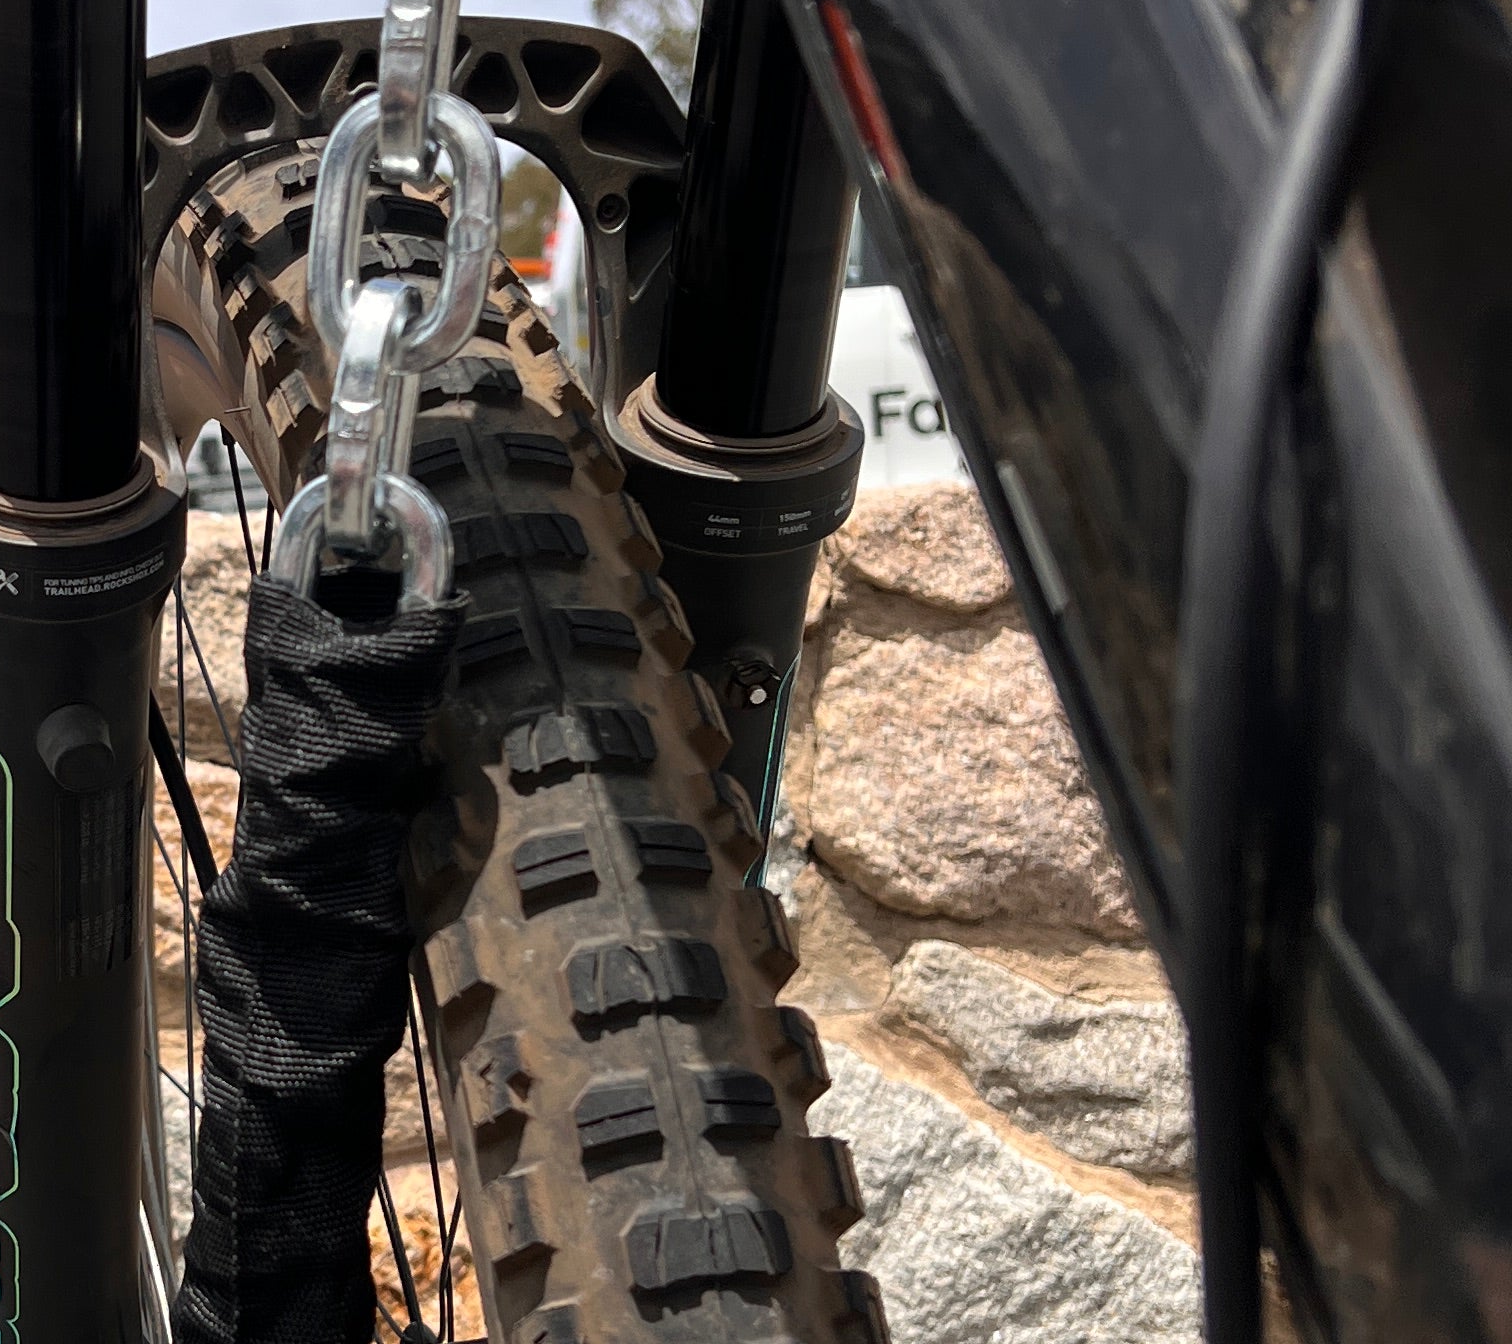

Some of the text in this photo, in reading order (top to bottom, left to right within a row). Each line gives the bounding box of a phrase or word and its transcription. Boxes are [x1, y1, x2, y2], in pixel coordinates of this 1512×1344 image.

[707, 514, 740, 525] 44mm
[704, 527, 742, 538] OFFSET
[778, 523, 808, 536] TRAVEL
